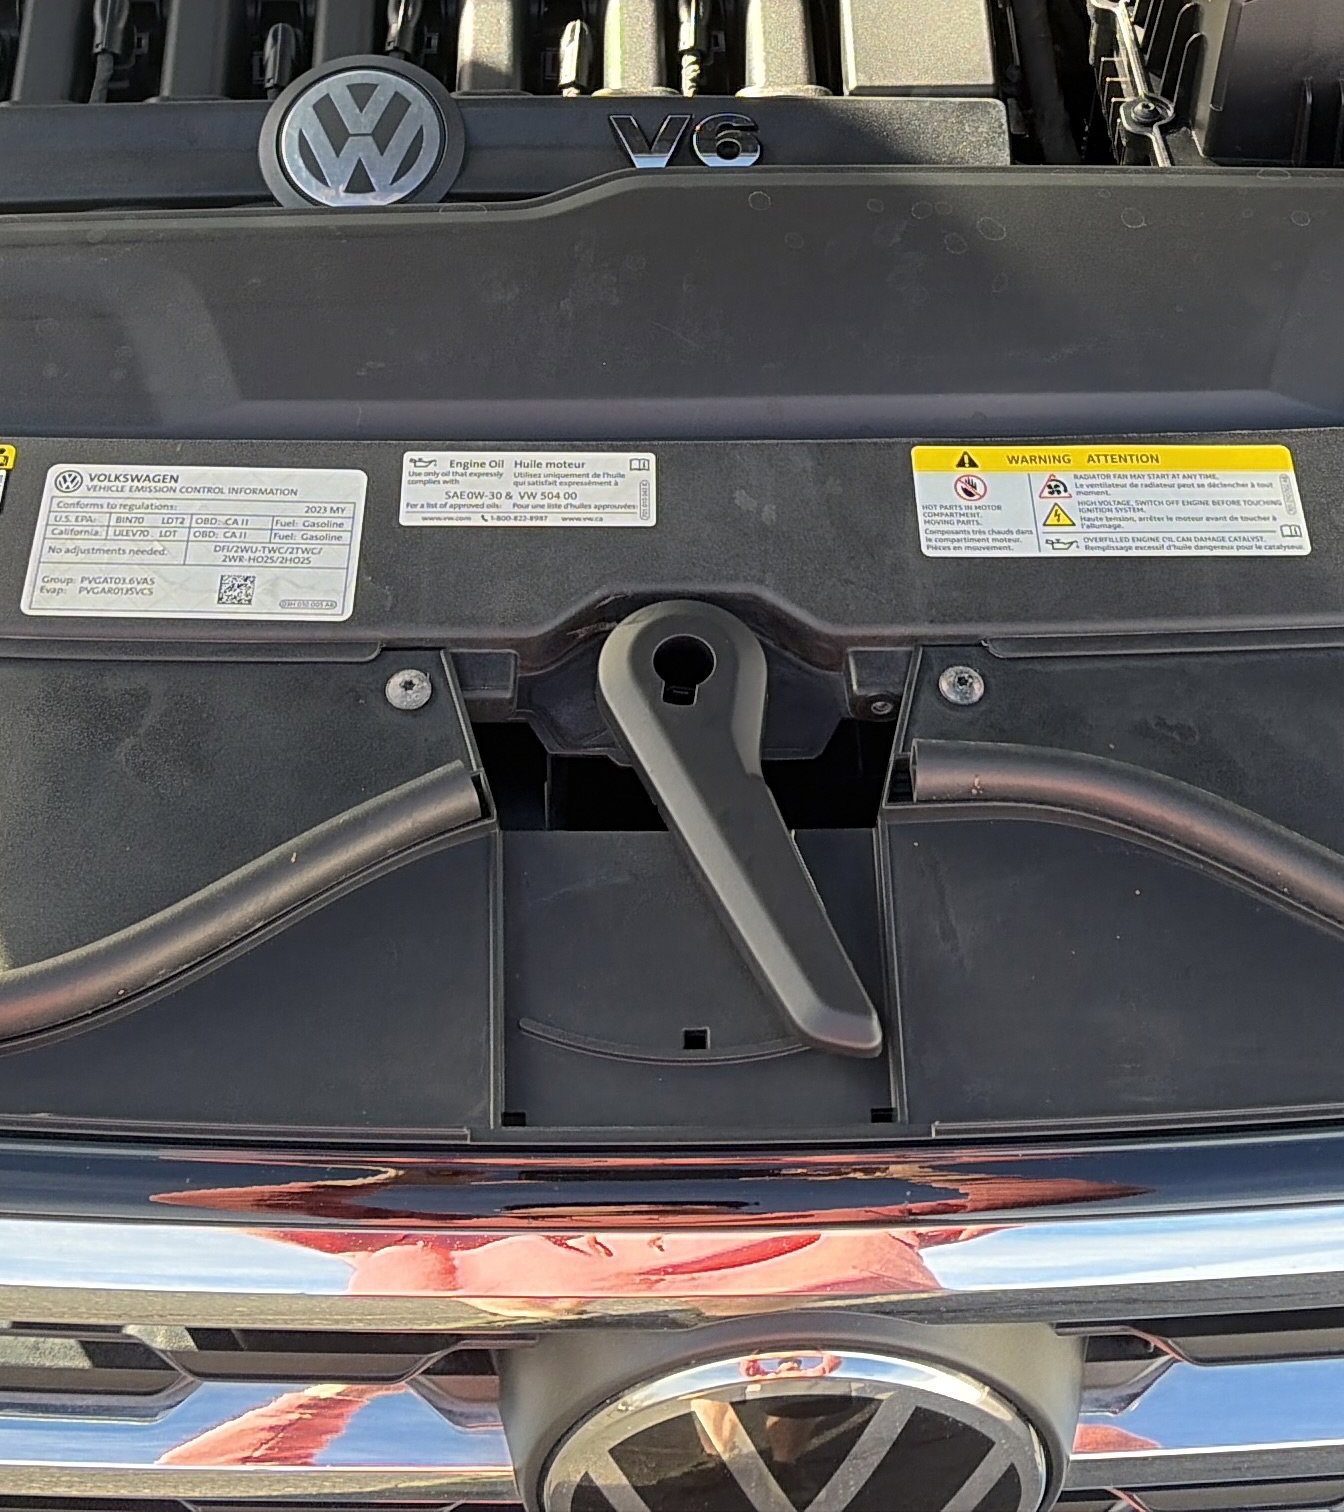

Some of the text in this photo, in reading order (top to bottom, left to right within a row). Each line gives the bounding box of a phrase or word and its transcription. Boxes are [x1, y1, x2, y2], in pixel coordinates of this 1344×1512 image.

[608, 114, 762, 167] V6
[449, 459, 586, 470] Engine Oil Huile moteur
[1007, 454, 1160, 465] WARNING ATTENTION
[88, 473, 180, 484] VOLKSWAGEN
[424, 470, 440, 478] only
[468, 470, 504, 479] expressly
[513, 471, 542, 479] Utilisez
[543, 471, 590, 480] uniquement
[591, 471, 601, 479] de
[407, 478, 441, 486] complies
[513, 480, 526, 488] qui
[85, 484, 298, 497] VEHICLE EMISSION CONTROL INFORMATION
[505, 491, 578, 500] & VW 504 00
[56, 500, 346, 514] Conforms to regulations: 2023 MY
[449, 502, 485, 510] approved
[54, 514, 72, 523] U.S.
[74, 515, 97, 523] EPA:
[115, 516, 145, 525] BIN70
[161, 516, 186, 525] LDT2
[194, 517, 219, 526] OBD:
[275, 519, 298, 528] Fuel:
[302, 519, 345, 529] Gasoline
[113, 529, 150, 538] ULEV70
[158, 530, 178, 538] LDT
[192, 530, 219, 539] OBD:
[273, 532, 297, 541] Fuel:
[300, 532, 343, 542] Gasoline
[924, 528, 971, 536] Composants
[934, 537, 990, 545] compartiment
[47, 545, 63, 554] No
[64, 545, 127, 557] adjustments
